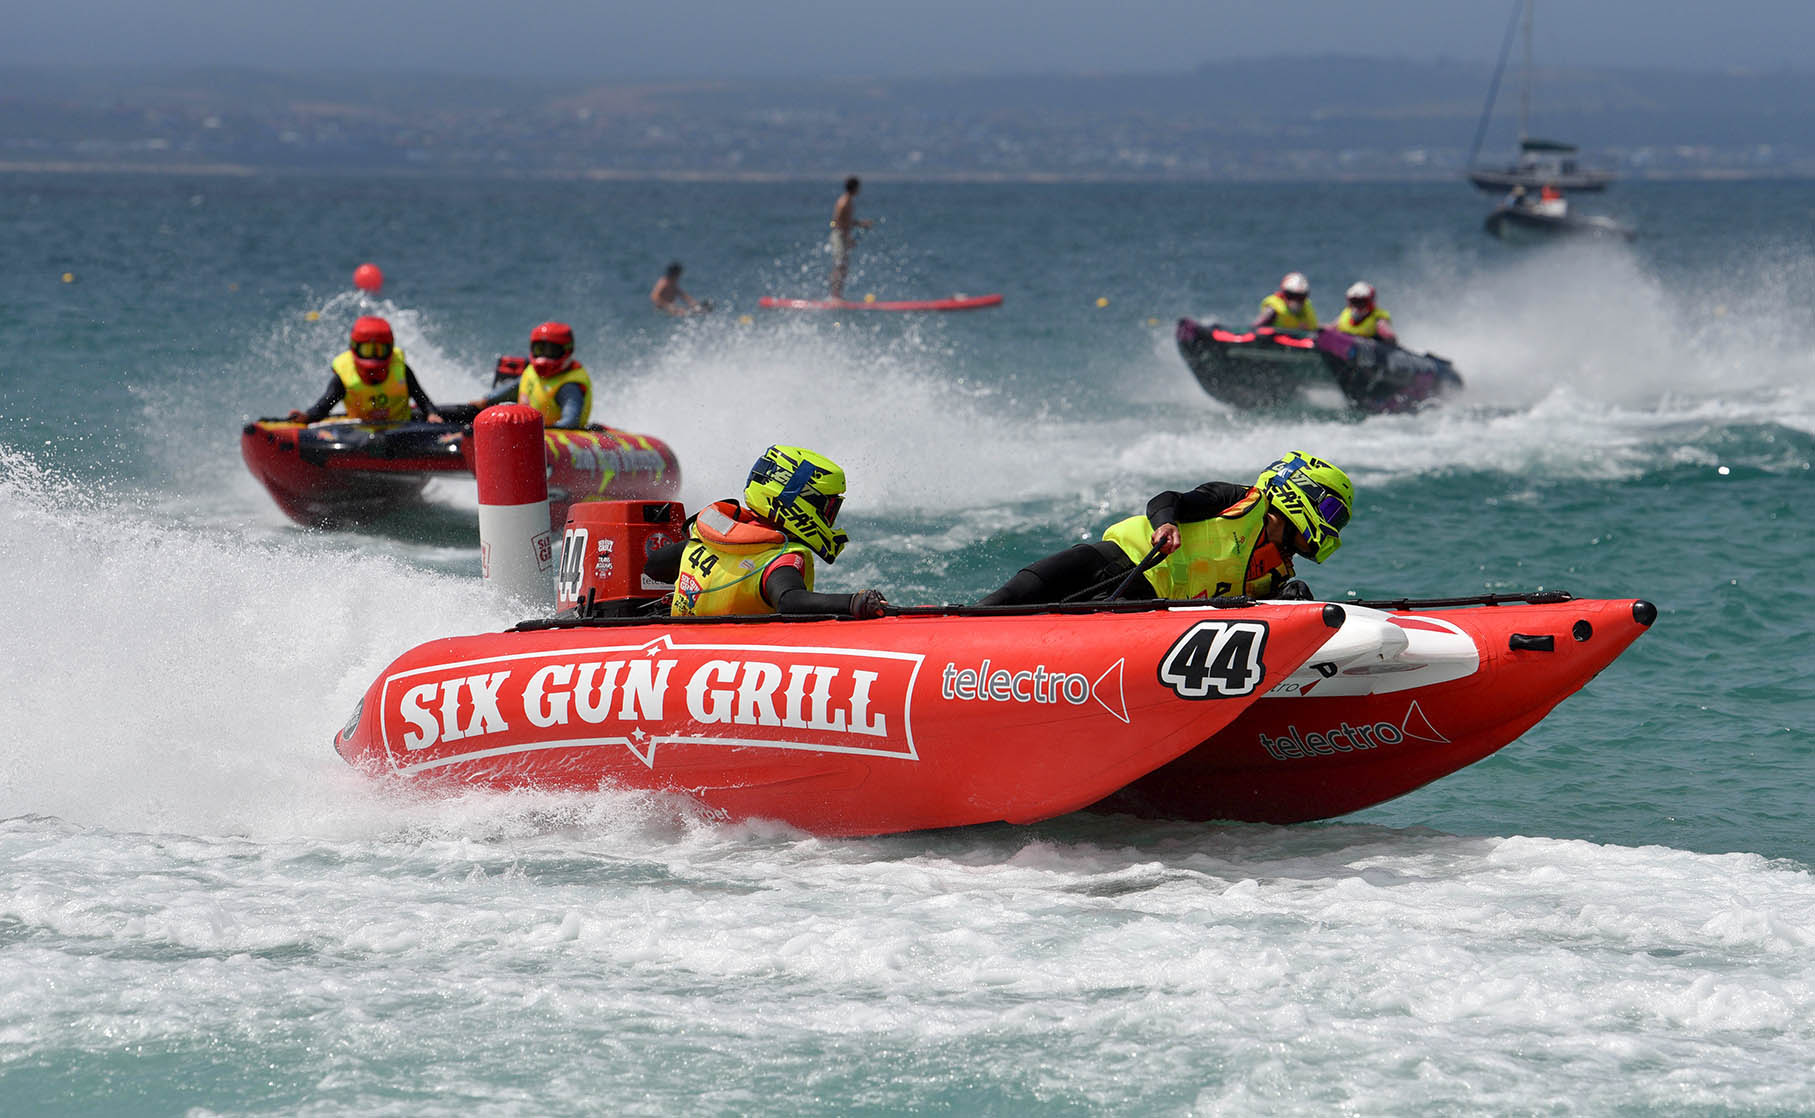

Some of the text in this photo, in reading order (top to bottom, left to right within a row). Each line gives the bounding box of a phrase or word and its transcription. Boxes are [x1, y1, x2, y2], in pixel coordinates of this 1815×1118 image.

[688, 545, 719, 578] 44
[942, 659, 1090, 704] telectro
[1160, 621, 1267, 697] 44
[400, 671, 510, 750] SIX
[521, 660, 678, 728] GUN
[685, 660, 888, 737] GRILL
[1259, 721, 1404, 760] telectro
